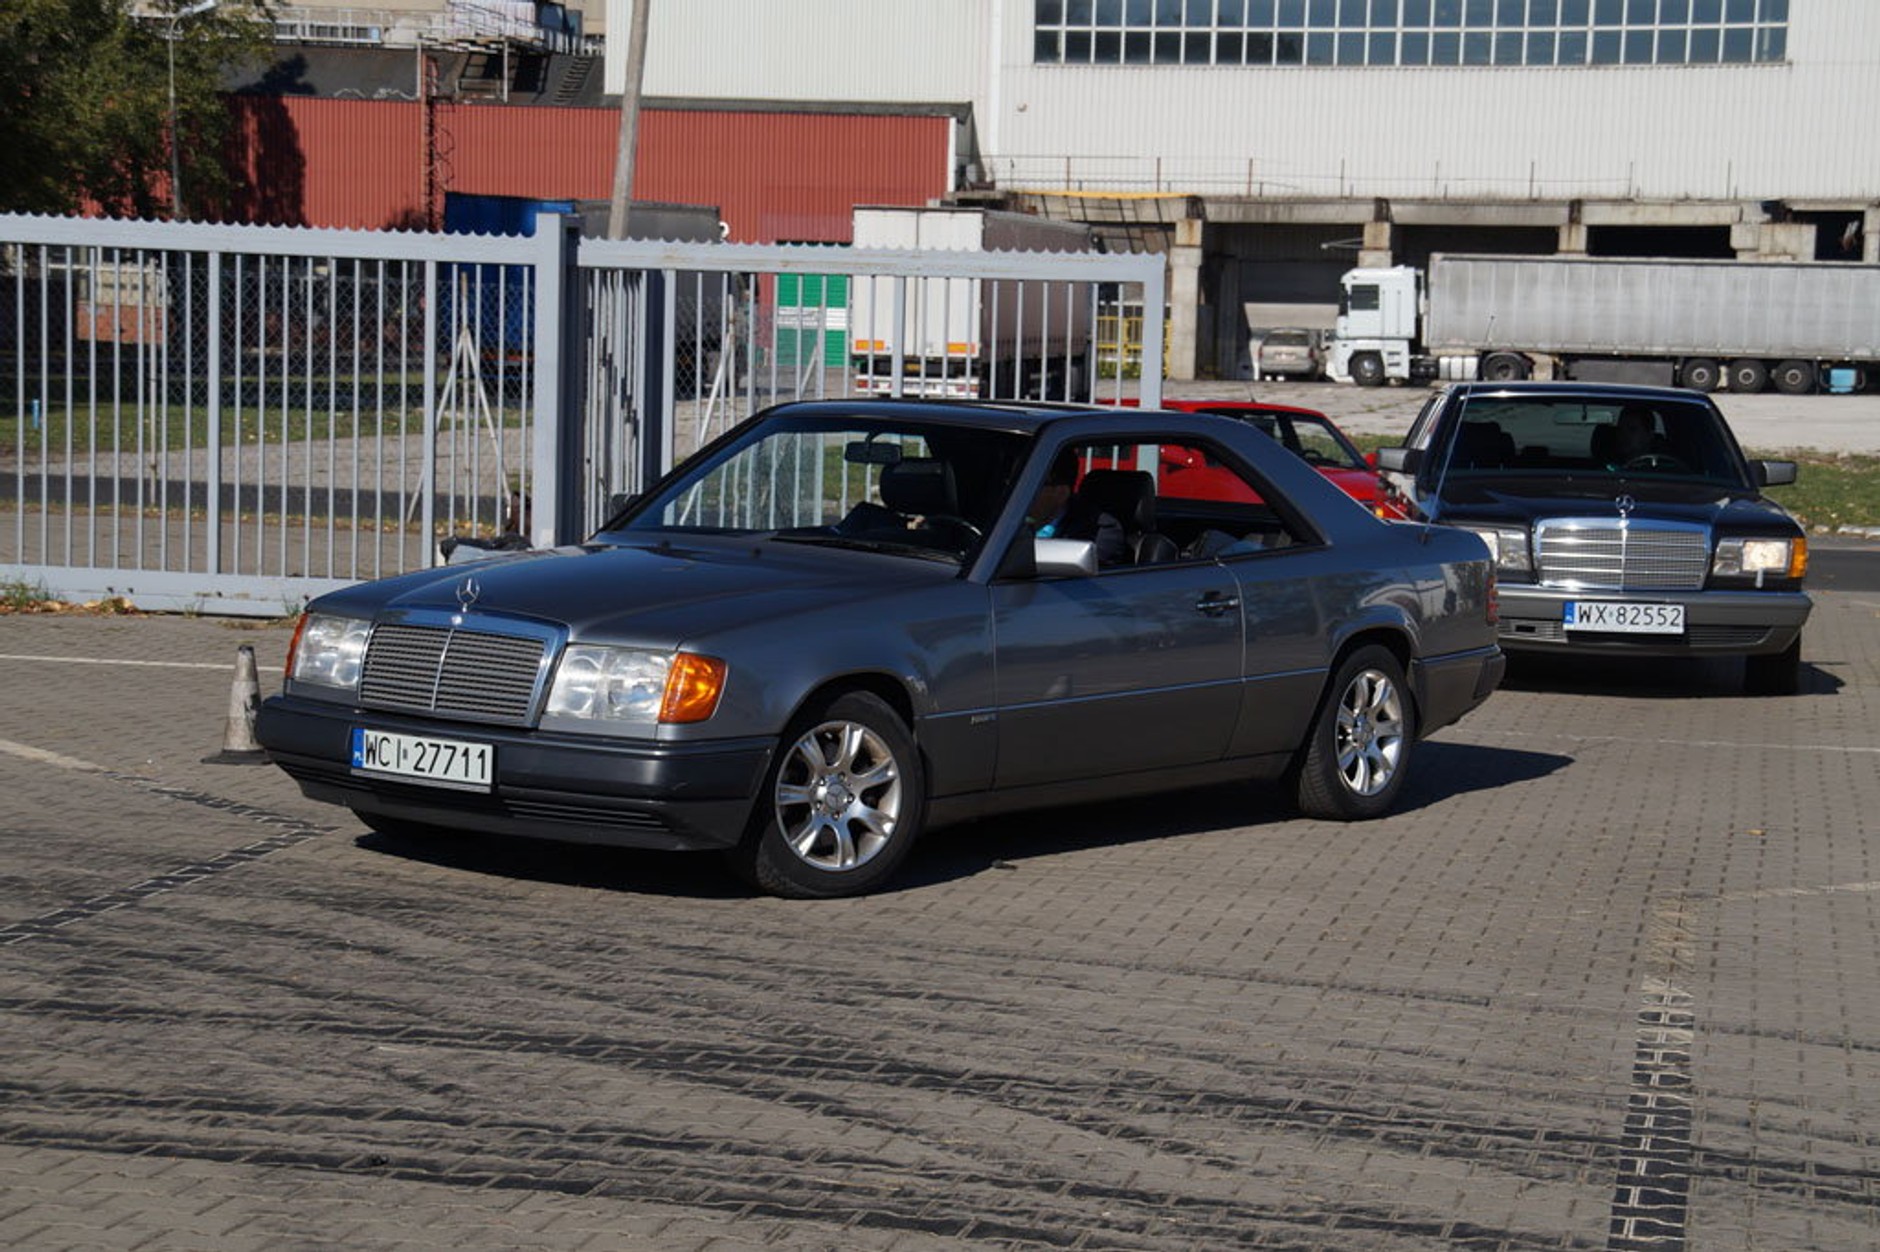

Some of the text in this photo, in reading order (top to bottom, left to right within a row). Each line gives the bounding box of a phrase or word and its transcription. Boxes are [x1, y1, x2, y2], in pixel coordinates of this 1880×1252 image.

[1578, 605, 1607, 624] WX
[1615, 606, 1681, 627] 82552
[365, 734, 486, 780] WCI 27711
